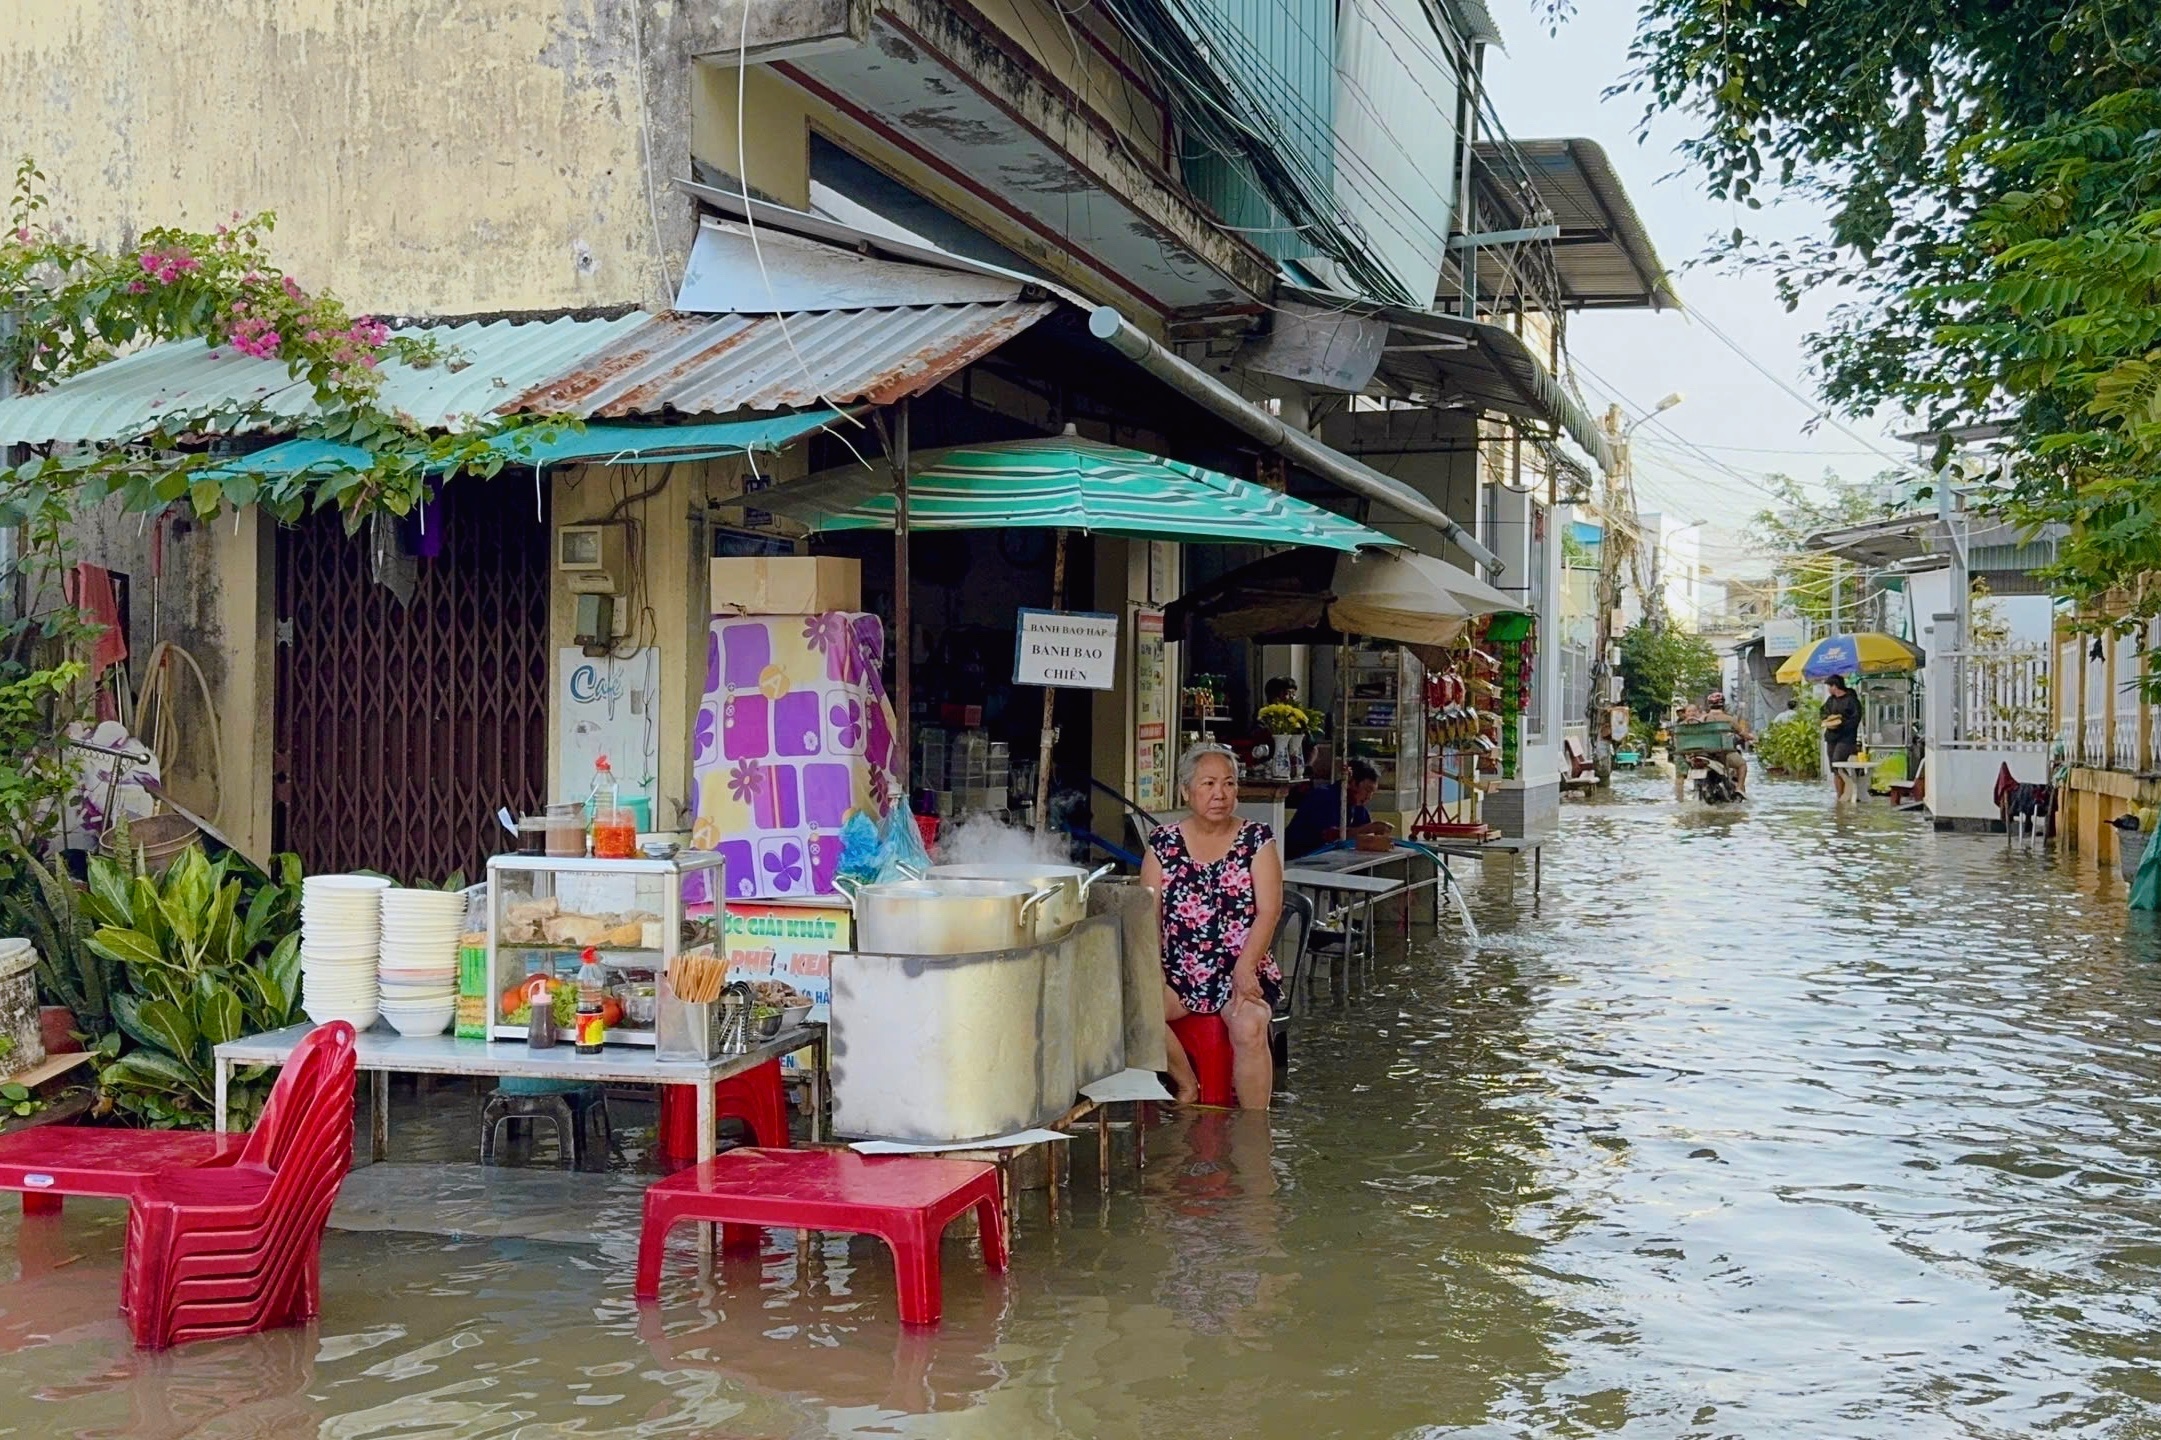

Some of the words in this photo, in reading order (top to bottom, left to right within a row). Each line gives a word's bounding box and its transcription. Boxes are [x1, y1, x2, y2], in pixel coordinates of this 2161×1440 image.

[1062, 626, 1084, 635] BAO
[1074, 647, 1102, 659] BAO
[746, 913, 783, 937] GIẢI
[786, 916, 837, 939] KHÁT
